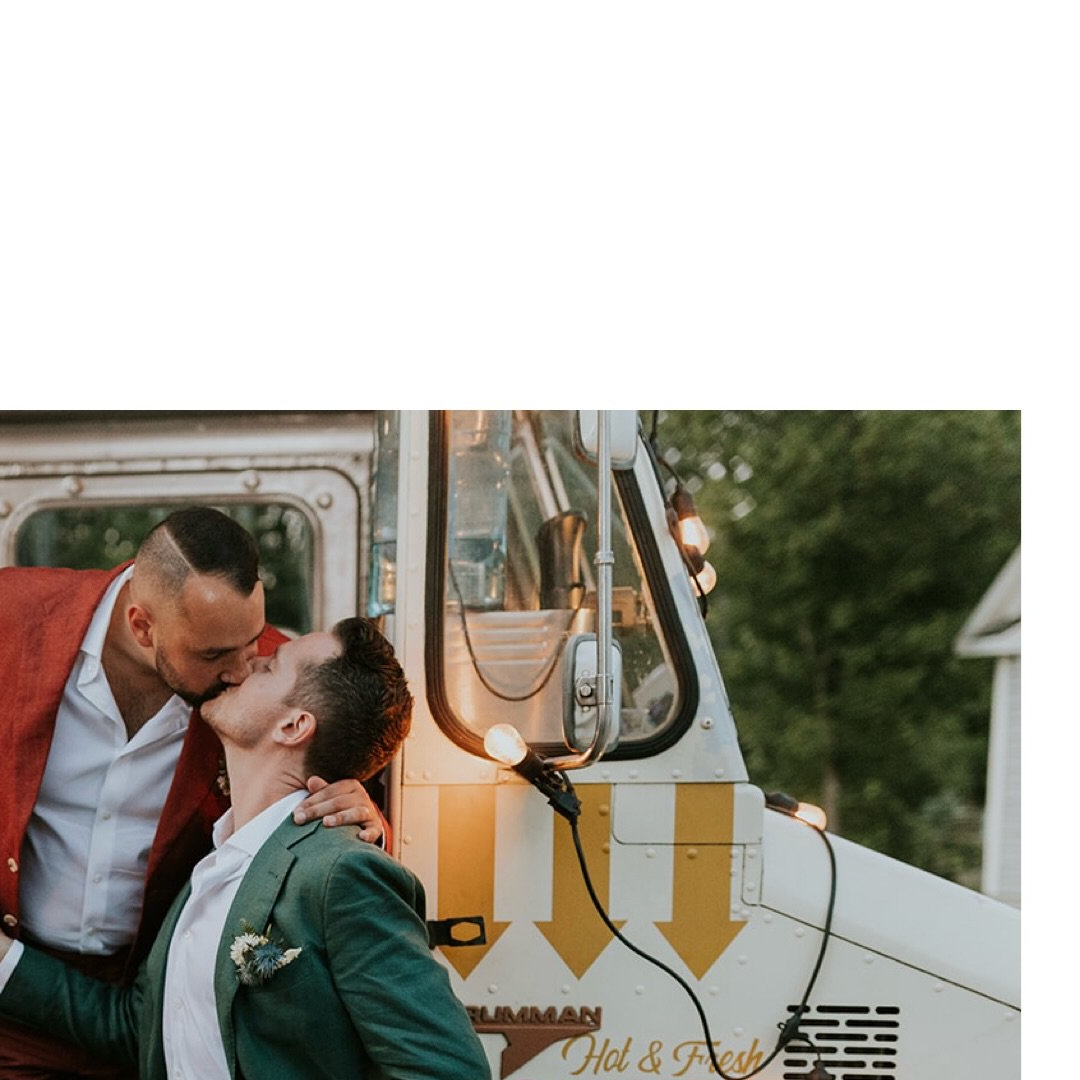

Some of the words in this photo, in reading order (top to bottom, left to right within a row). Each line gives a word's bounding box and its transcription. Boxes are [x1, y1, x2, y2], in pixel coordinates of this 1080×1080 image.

[466, 1006, 602, 1027] RUMMAN
[562, 1034, 632, 1076] Hot
[638, 1040, 664, 1075] &
